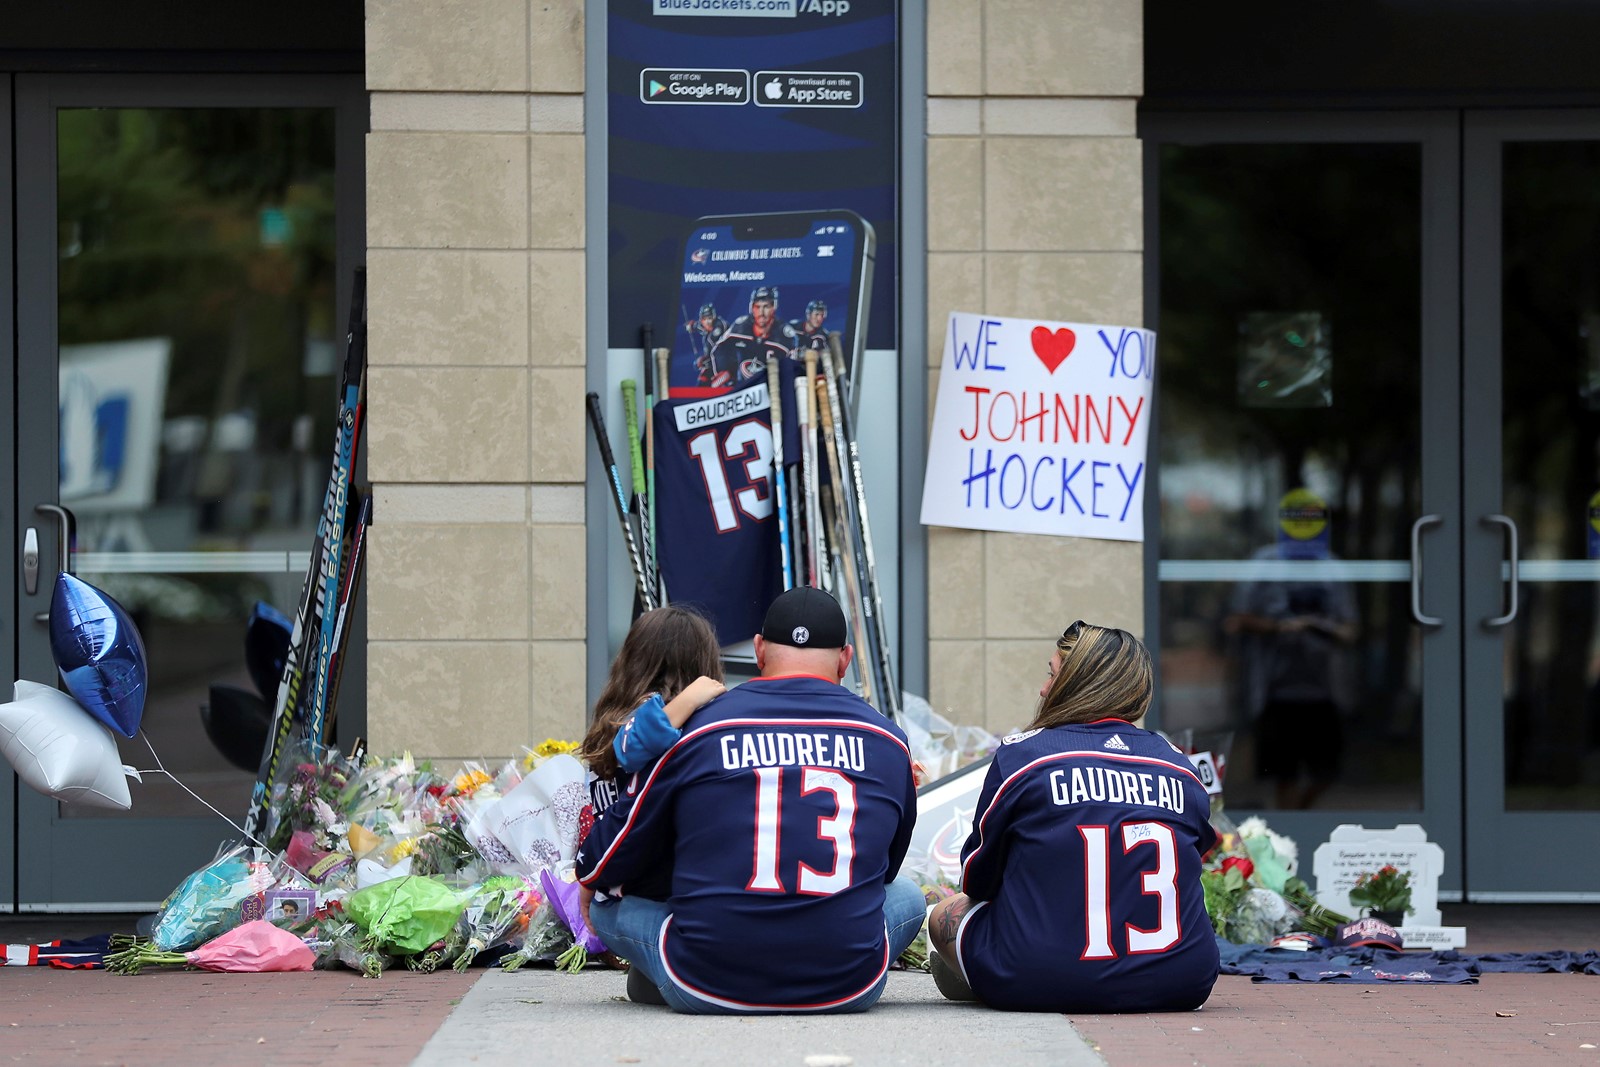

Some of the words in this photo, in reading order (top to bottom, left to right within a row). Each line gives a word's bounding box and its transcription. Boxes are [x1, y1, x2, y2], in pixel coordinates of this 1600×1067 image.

[659, 0, 791, 11] BlueJackets.com
[799, 0, 850, 16] /App
[668, 81, 714, 99] Google
[715, 82, 743, 99] Play
[669, 73, 682, 81] GET
[683, 73, 690, 81] IT
[787, 86, 816, 103] App
[816, 87, 853, 101] Store
[788, 77, 827, 86] Download
[838, 78, 852, 86] the
[711, 249, 749, 262] COLUMBUS
[750, 248, 769, 260] BLUE
[684, 271, 729, 283] Welcome,
[729, 270, 765, 281] Marcus
[952, 317, 1006, 371] WE
[686, 388, 763, 425] GAUDREAU
[960, 386, 1144, 446] JOHNNY
[687, 417, 774, 535] 13
[962, 448, 1144, 521] HOCKEY
[327, 466, 348, 580] EASTON
[720, 732, 865, 772] GAUDREAU
[1104, 742, 1130, 751] adidas
[1049, 767, 1184, 814] GAUDREAU
[745, 765, 857, 896] 13
[1076, 820, 1182, 960] 13
